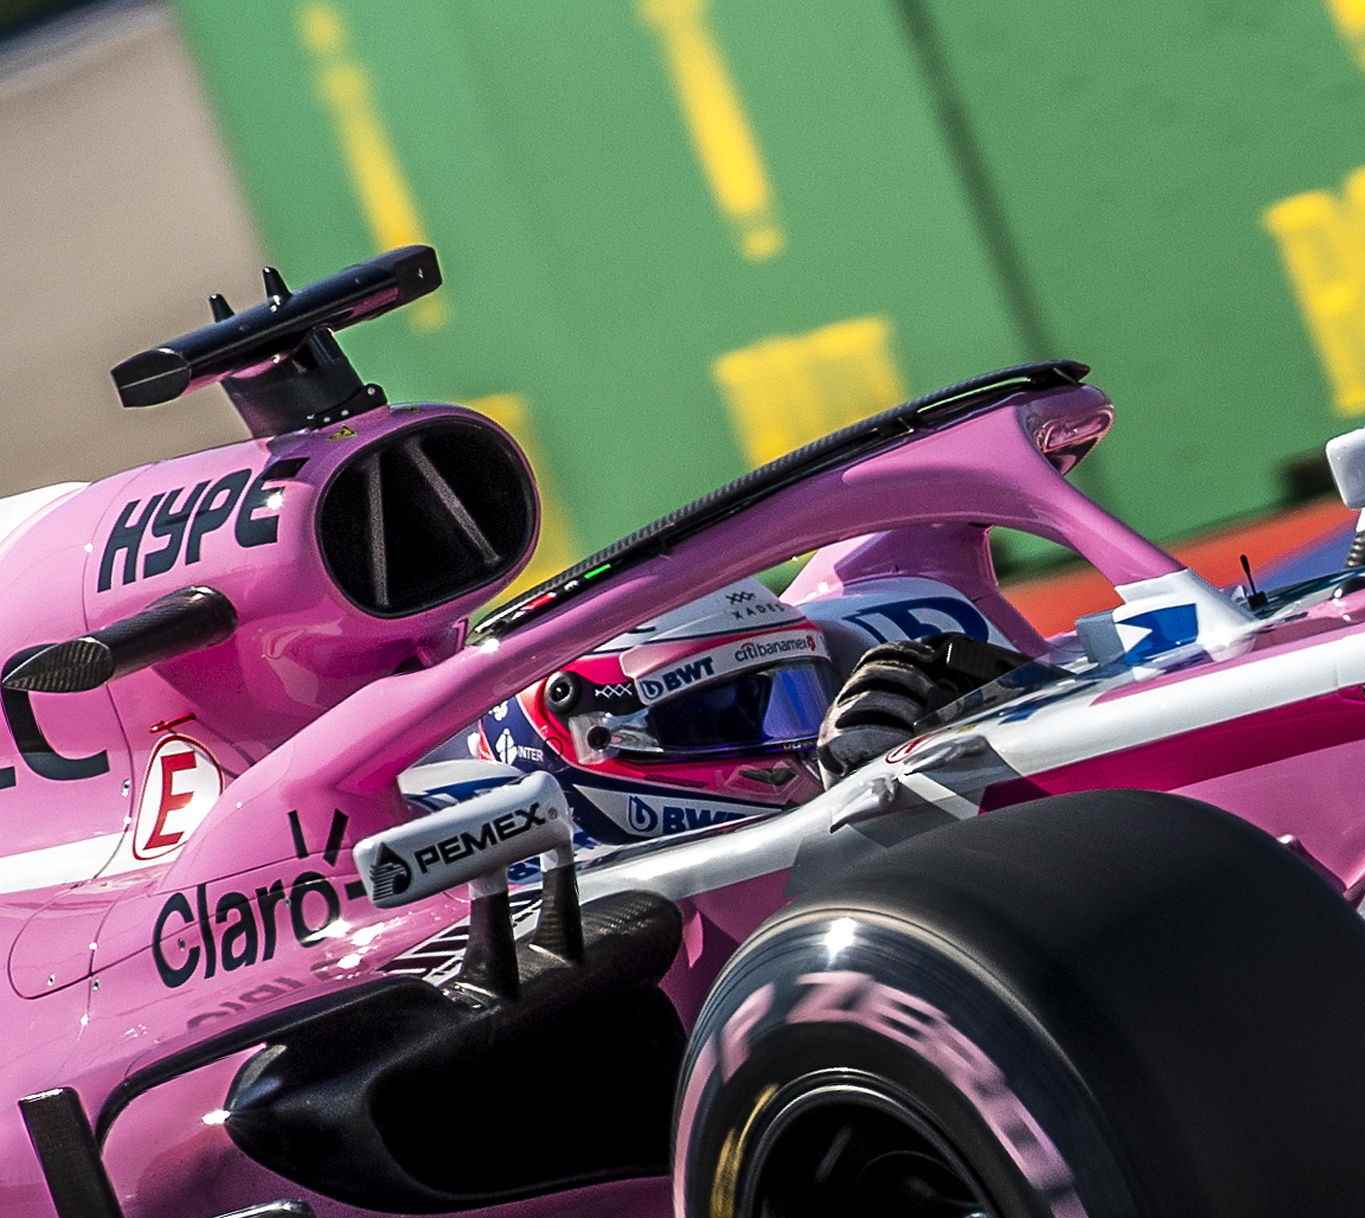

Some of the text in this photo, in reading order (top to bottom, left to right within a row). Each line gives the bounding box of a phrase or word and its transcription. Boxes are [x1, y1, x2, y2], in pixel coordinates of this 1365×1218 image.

[97, 457, 310, 593] HYPE
[662, 656, 716, 692] BWT
[143, 751, 197, 851] E
[414, 801, 547, 874] PEMEX
[151, 870, 341, 989] Claro
